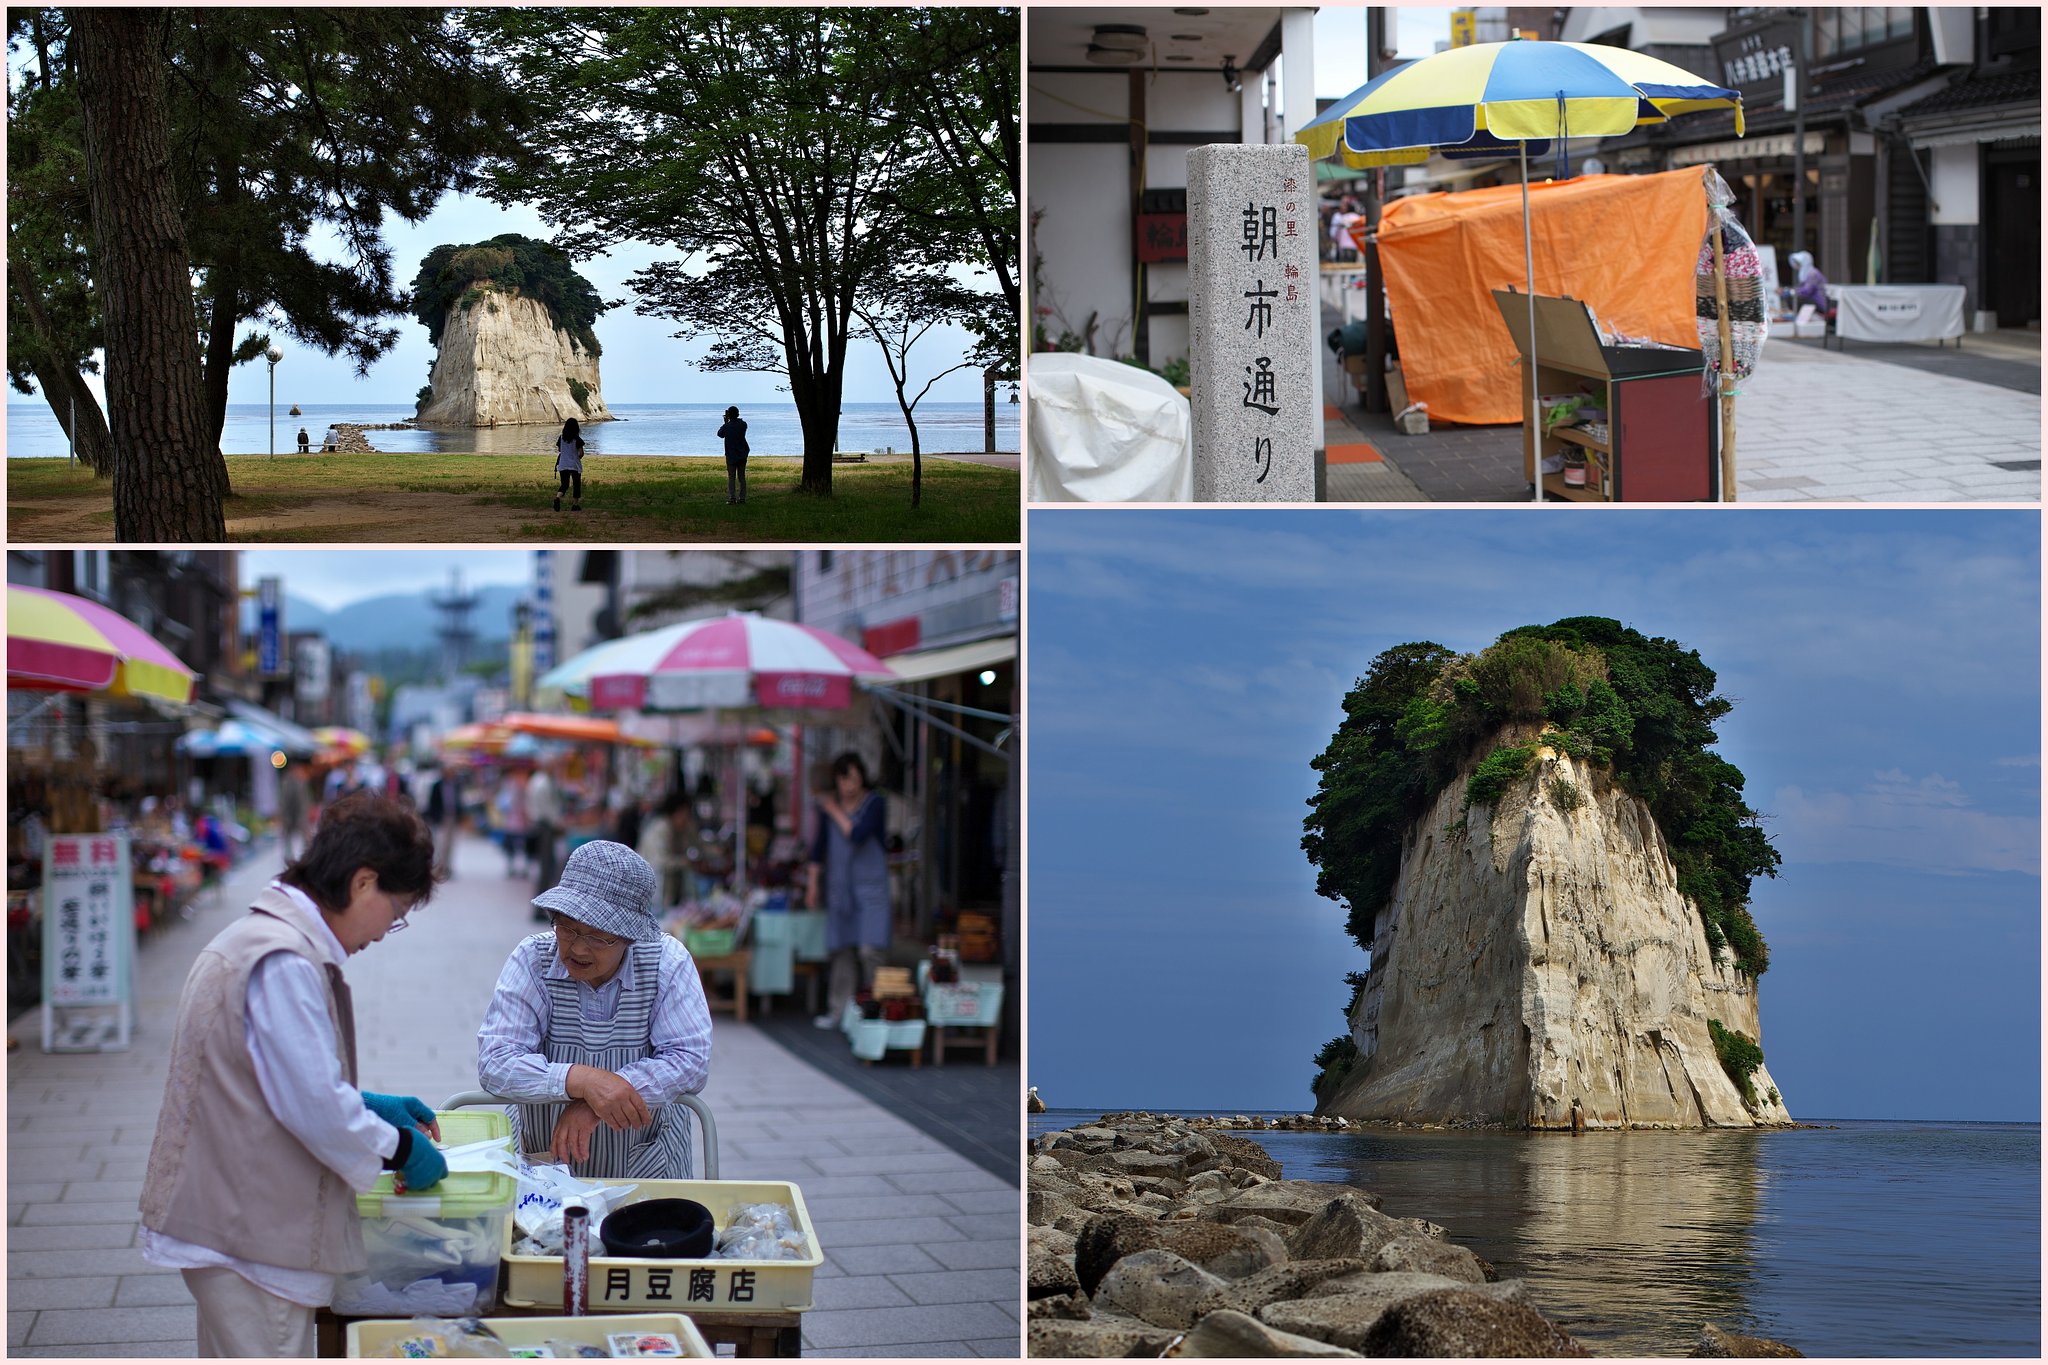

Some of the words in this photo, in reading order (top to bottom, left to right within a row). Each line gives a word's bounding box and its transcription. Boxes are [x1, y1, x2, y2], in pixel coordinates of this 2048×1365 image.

[1283, 178, 1298, 237] 漆の里
[1284, 263, 1299, 302] 輪島
[1241, 202, 1279, 484] 朝市通り
[53, 840, 117, 865] 無料
[605, 1267, 756, 1302] 月豆腐店
